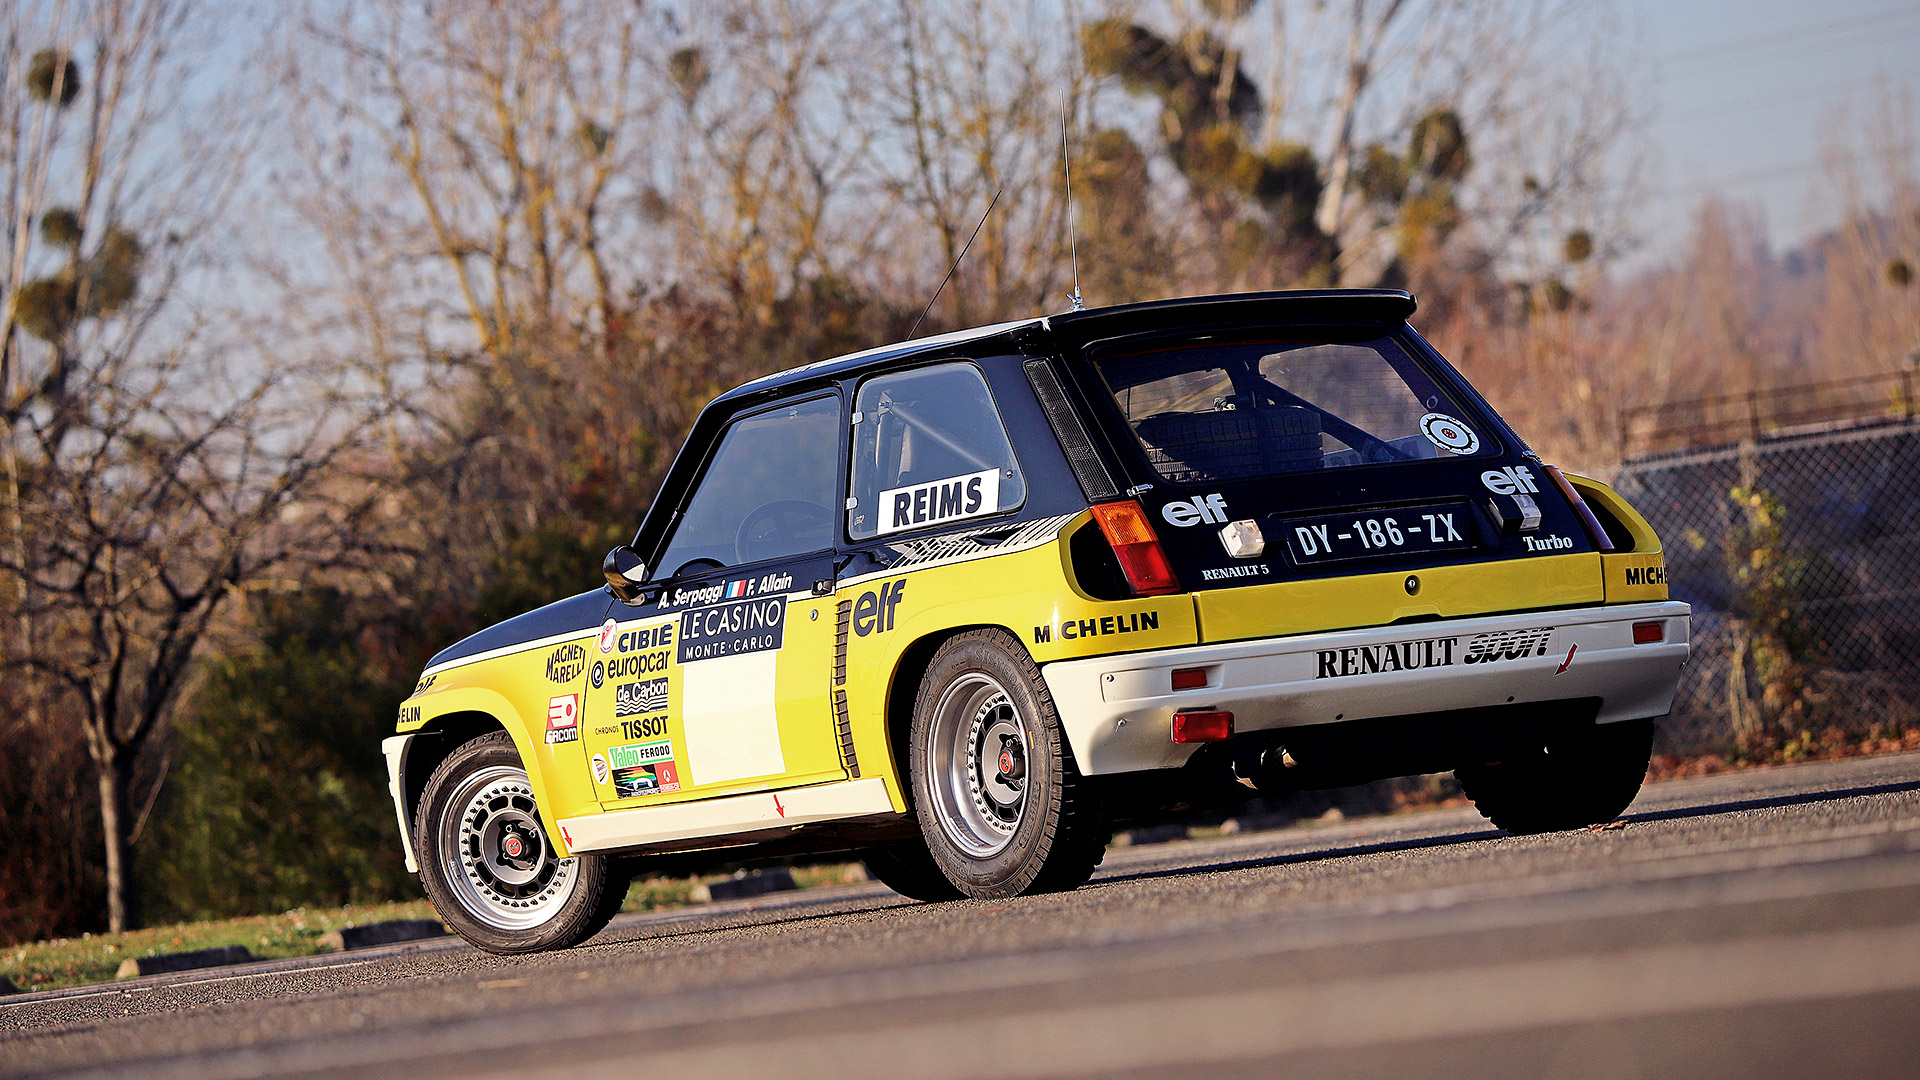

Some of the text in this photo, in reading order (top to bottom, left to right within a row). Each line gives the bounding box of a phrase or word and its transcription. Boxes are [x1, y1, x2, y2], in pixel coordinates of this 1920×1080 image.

[1481, 465, 1540, 495] elf
[892, 476, 983, 528] REIMS
[1162, 493, 1229, 527] elf
[1294, 512, 1463, 556] DY-186-ZX
[1523, 534, 1573, 553] Turbo
[746, 571, 793, 596] F. Allain
[1202, 564, 1269, 581] RENAULT 5
[657, 579, 726, 609] A. Serpaggi
[853, 578, 907, 637] elf
[681, 599, 782, 640] LE CASINO
[1033, 610, 1160, 644] MICHELIN
[545, 643, 586, 671] MAGNETI
[685, 634, 773, 660] MONTE CARLO
[1316, 626, 1556, 680] RENAULT sport
[545, 660, 585, 684] MARELLI
[607, 650, 671, 680] europcar
[617, 679, 668, 704] de Carbon
[594, 715, 669, 740] CHRONOS TISSOT
[609, 746, 639, 768] Valeo
[640, 744, 670, 759] FERODO
